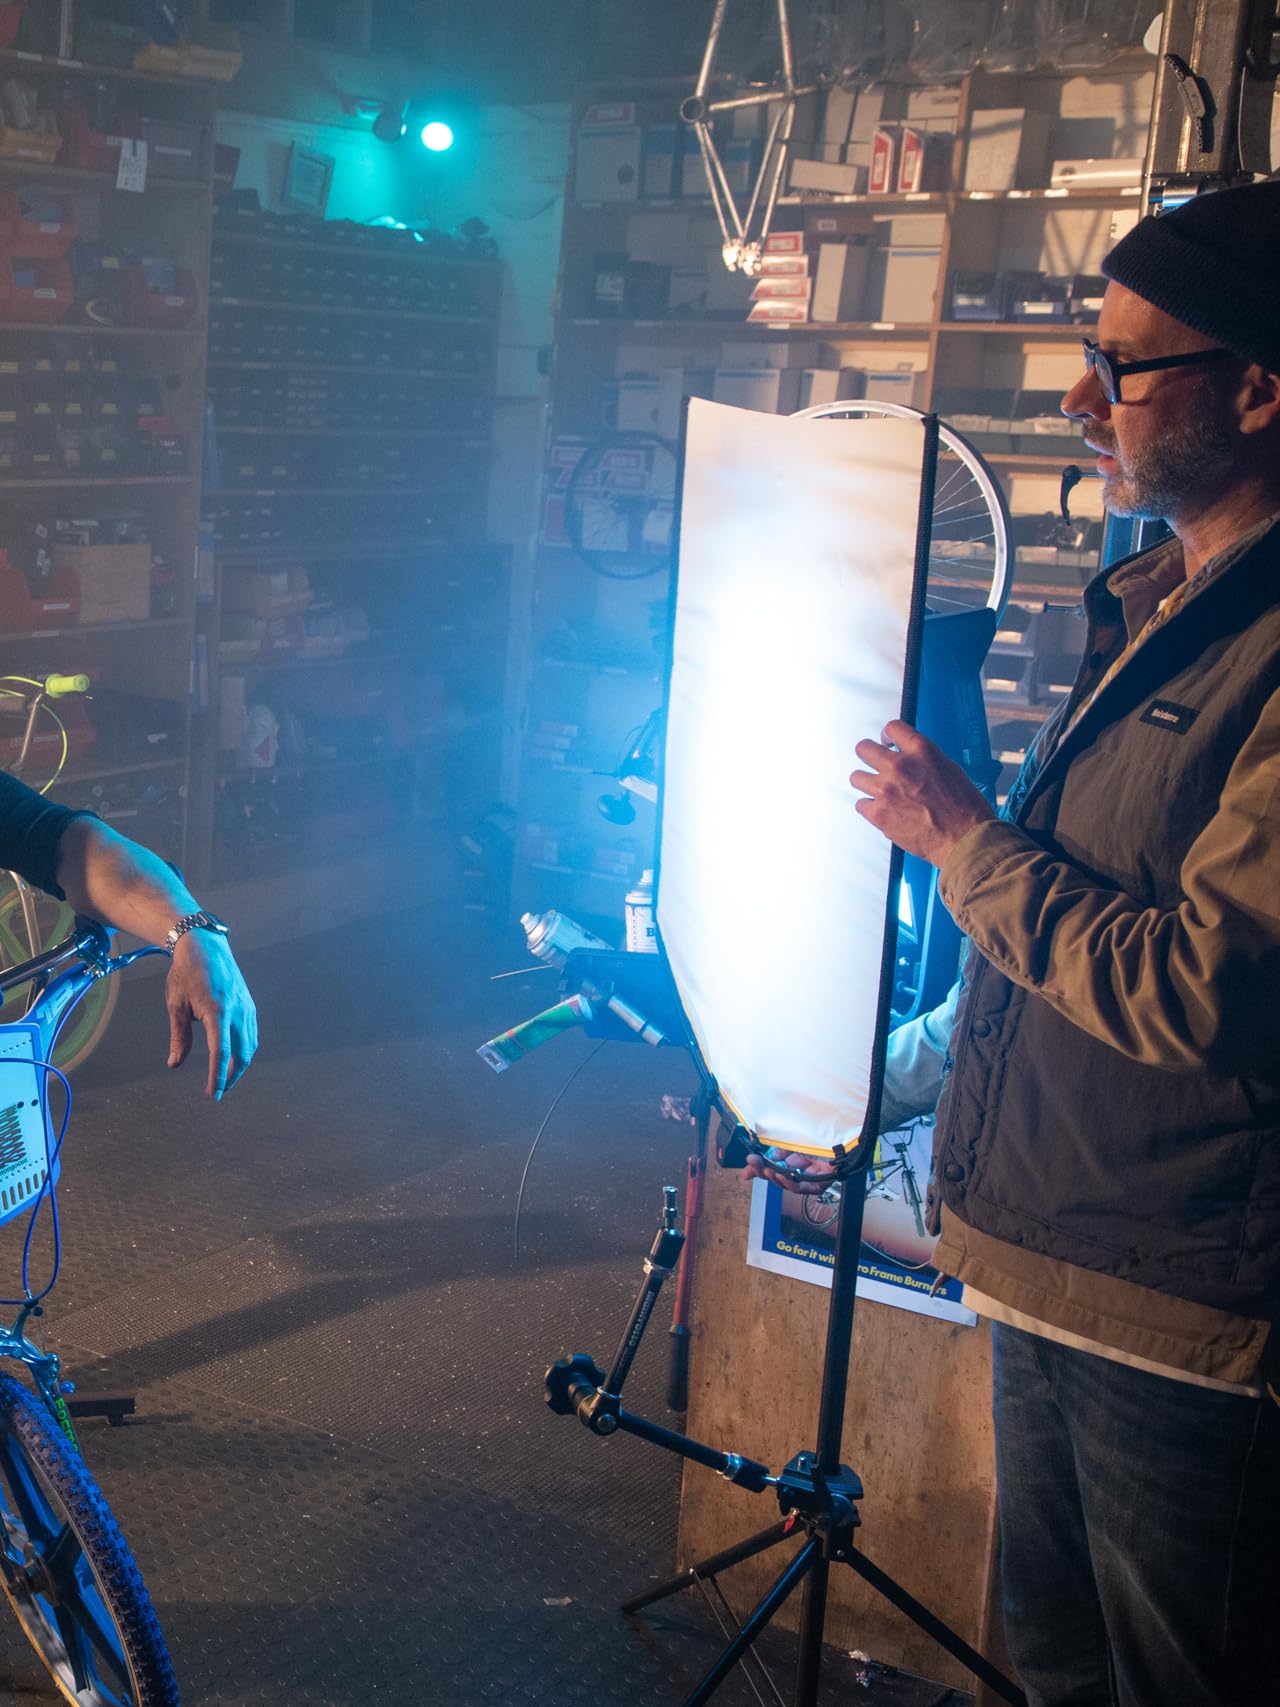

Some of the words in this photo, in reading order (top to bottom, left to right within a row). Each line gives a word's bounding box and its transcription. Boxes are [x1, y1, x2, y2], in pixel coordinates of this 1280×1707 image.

[776, 1240, 792, 1252] Go
[793, 1244, 809, 1256] for
[809, 1249, 817, 1259] it
[818, 1253, 836, 1265] wit
[869, 1266, 903, 1283] Frame
